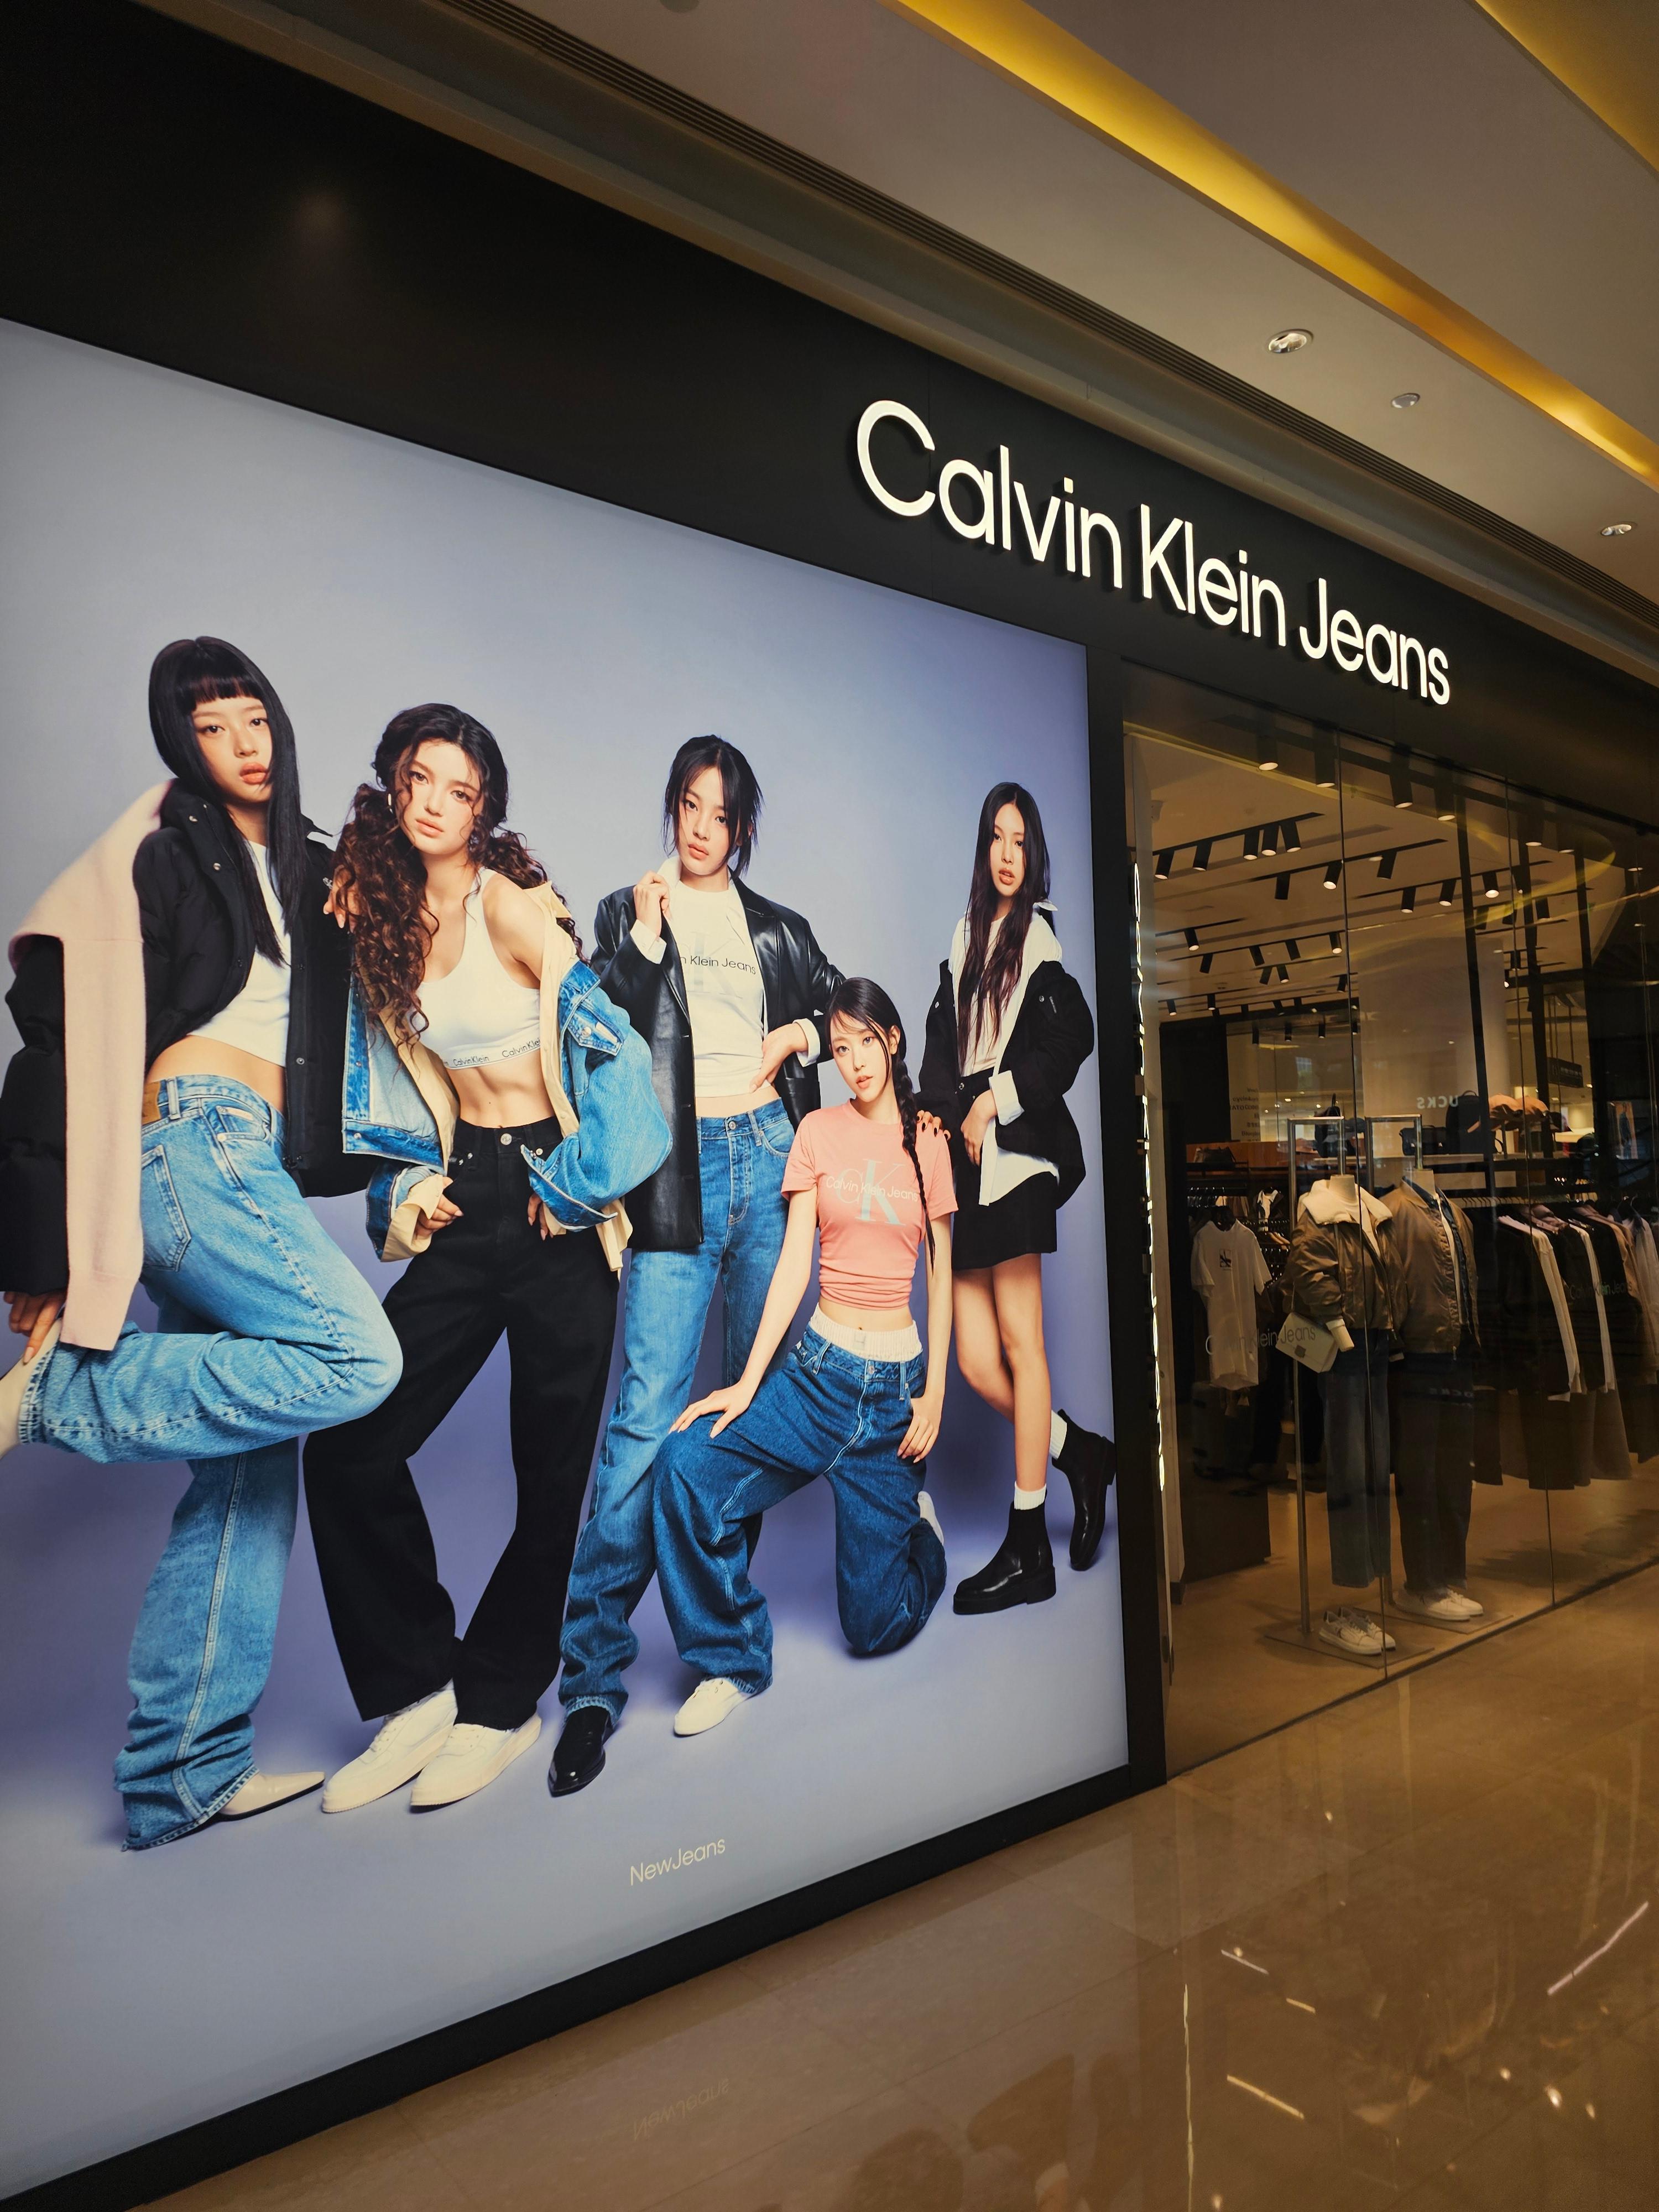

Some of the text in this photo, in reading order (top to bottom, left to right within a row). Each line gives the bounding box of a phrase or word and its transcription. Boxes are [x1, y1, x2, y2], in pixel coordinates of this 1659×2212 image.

[857, 400, 1450, 705] Calvin Klein Jeans
[690, 955, 719, 967] Klein
[722, 958, 756, 975] Jeans
[526, 1037, 541, 1048] Klei
[826, 1176, 919, 1202] Calvin Klein Jeans
[1570, 1283, 1593, 1300] Calin
[1611, 1280, 1632, 1295] Jeas
[1280, 1325, 1316, 1344] Jeans
[630, 1839, 726, 1886] NewJeans
